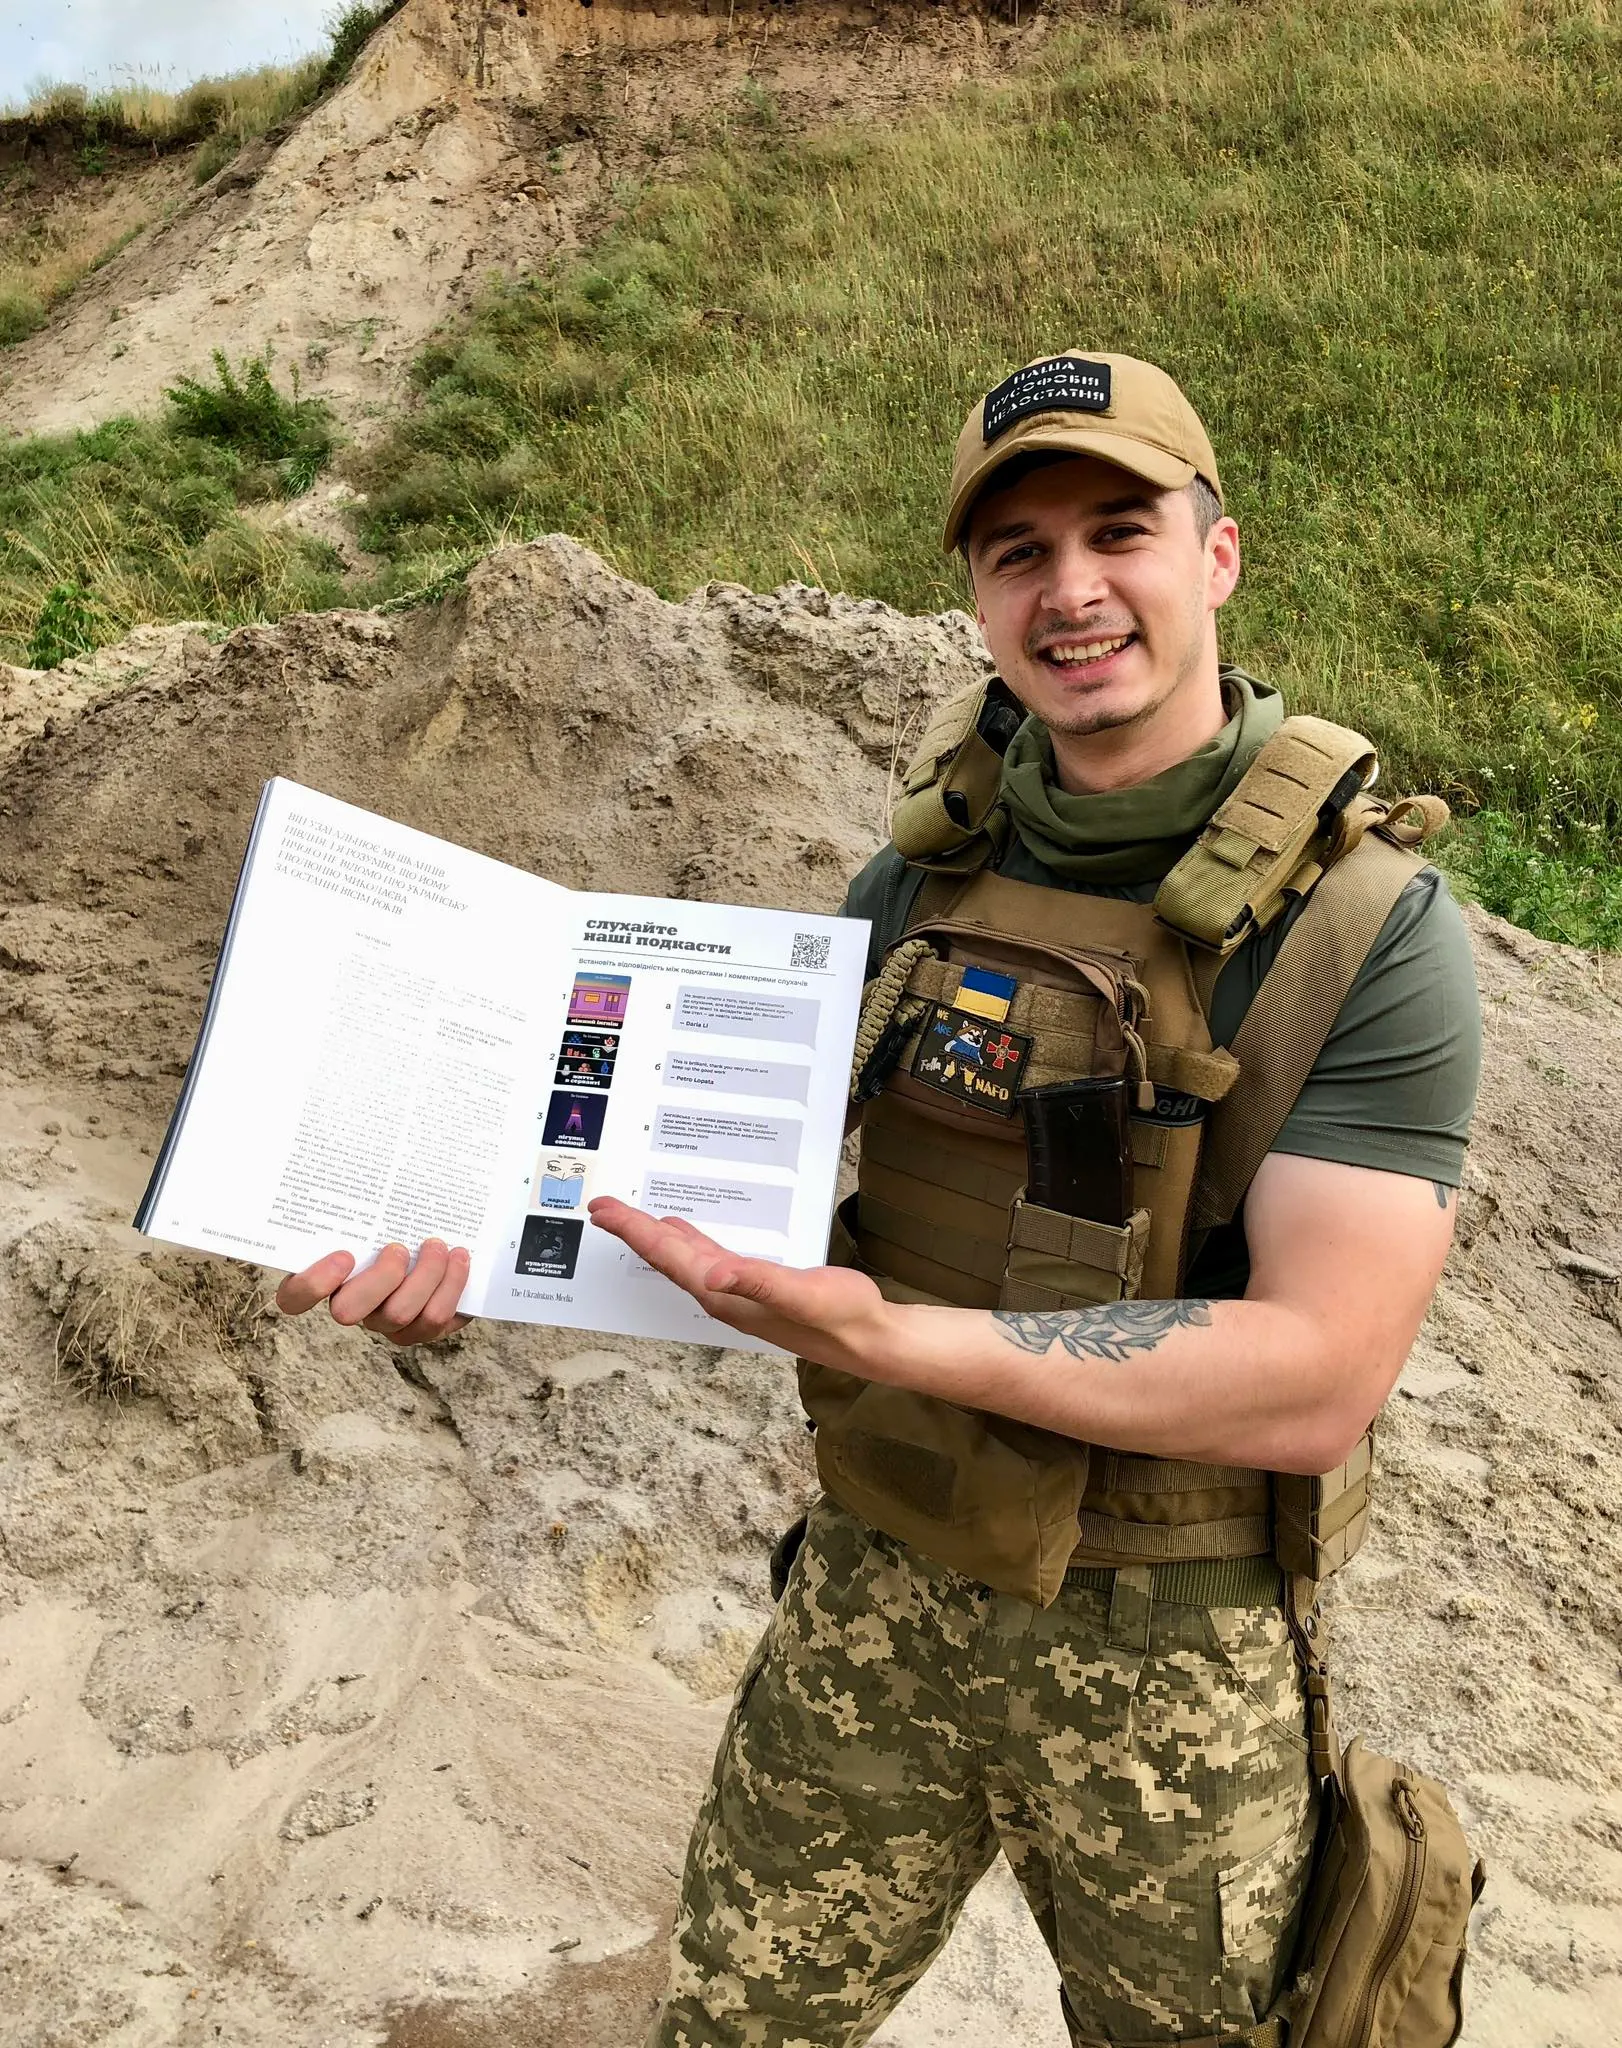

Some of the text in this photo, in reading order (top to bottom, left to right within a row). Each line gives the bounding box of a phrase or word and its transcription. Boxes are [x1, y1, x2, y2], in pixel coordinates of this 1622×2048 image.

[1014, 361, 1076, 384] НАША
[991, 375, 1099, 412] РУСОФОБІЯ
[988, 388, 1104, 430] НЕДОСТАТНЯ
[586, 920, 678, 936] слухайте
[584, 932, 731, 954] наші подкасти
[578, 958, 616, 967] Встановіть
[618, 961, 664, 972] відповідність
[681, 968, 723, 978] подкастами
[729, 973, 776, 984] коментарями
[778, 979, 808, 987] слухачів
[937, 1009, 950, 1020] WE
[934, 1021, 952, 1036] ARE
[920, 1057, 941, 1072] Fella
[975, 1078, 1008, 1100] NAFO
[654, 1202, 668, 1210] Irina
[669, 1204, 694, 1213] Kolyada
[525, 1261, 566, 1269] культурний
[528, 1267, 561, 1275] трибунал
[512, 1288, 573, 1302] The Ukrainians Media
